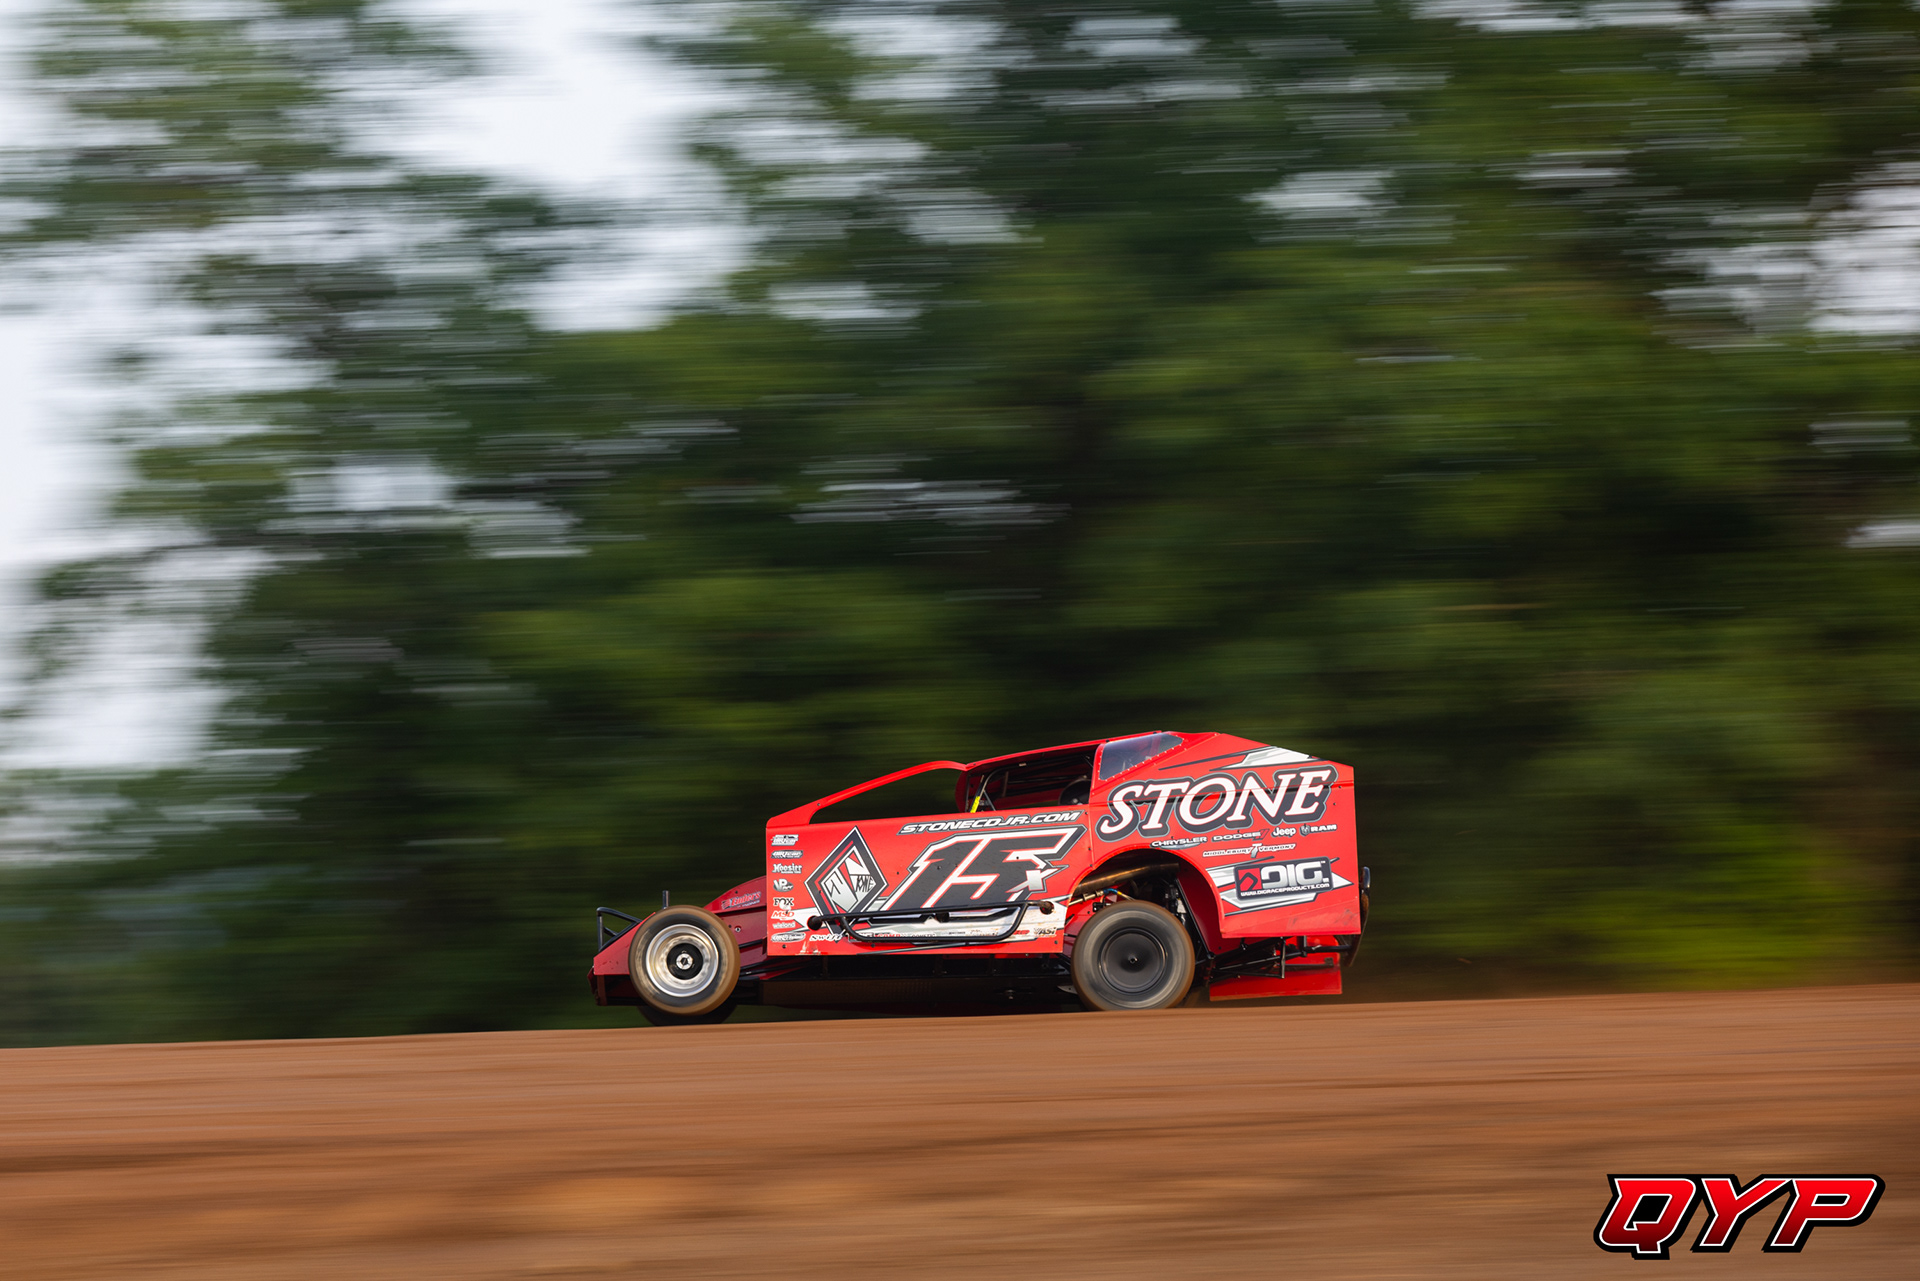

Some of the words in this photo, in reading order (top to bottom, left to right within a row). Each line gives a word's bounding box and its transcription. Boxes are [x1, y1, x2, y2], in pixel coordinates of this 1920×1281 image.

[1098, 768, 1334, 837] STONE
[899, 811, 1081, 834] STONECDJR.COM
[1272, 827, 1297, 837] Jeep
[1310, 824, 1338, 833] RAM
[1212, 831, 1262, 842] DODGE
[1152, 836, 1208, 848] CHRYSLER
[772, 863, 802, 873] Hoosier
[773, 897, 794, 906] FOX
